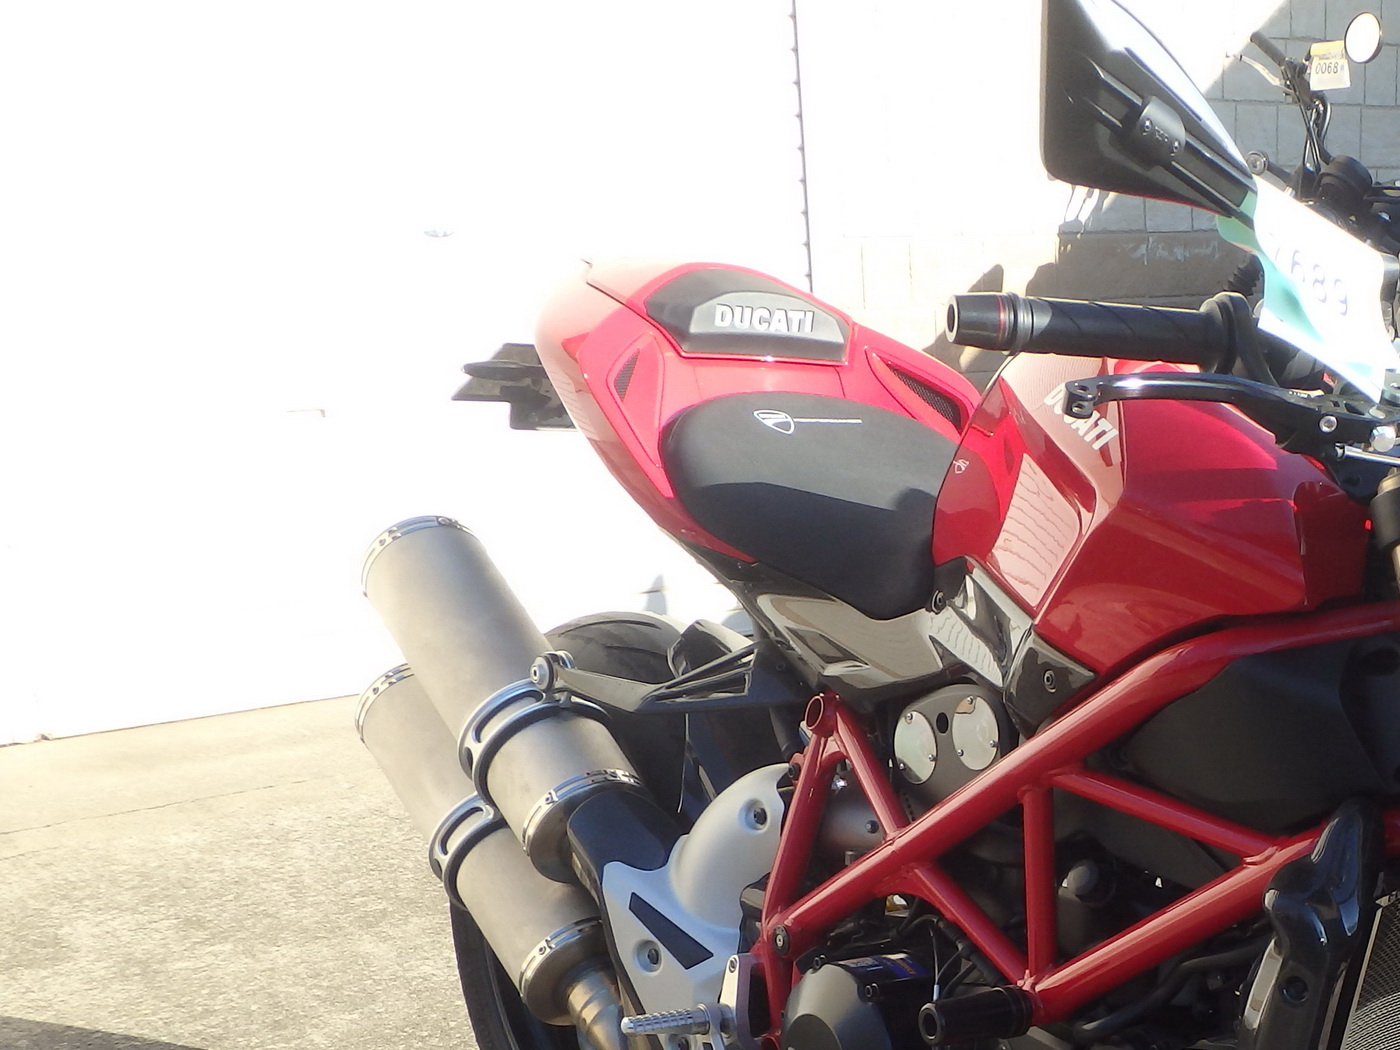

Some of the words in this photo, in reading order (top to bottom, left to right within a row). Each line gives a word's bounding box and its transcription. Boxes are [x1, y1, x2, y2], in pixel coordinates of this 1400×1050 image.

[1315, 61, 1339, 75] 0068
[714, 303, 815, 333] DUCATI
[1043, 382, 1120, 451] DATI
